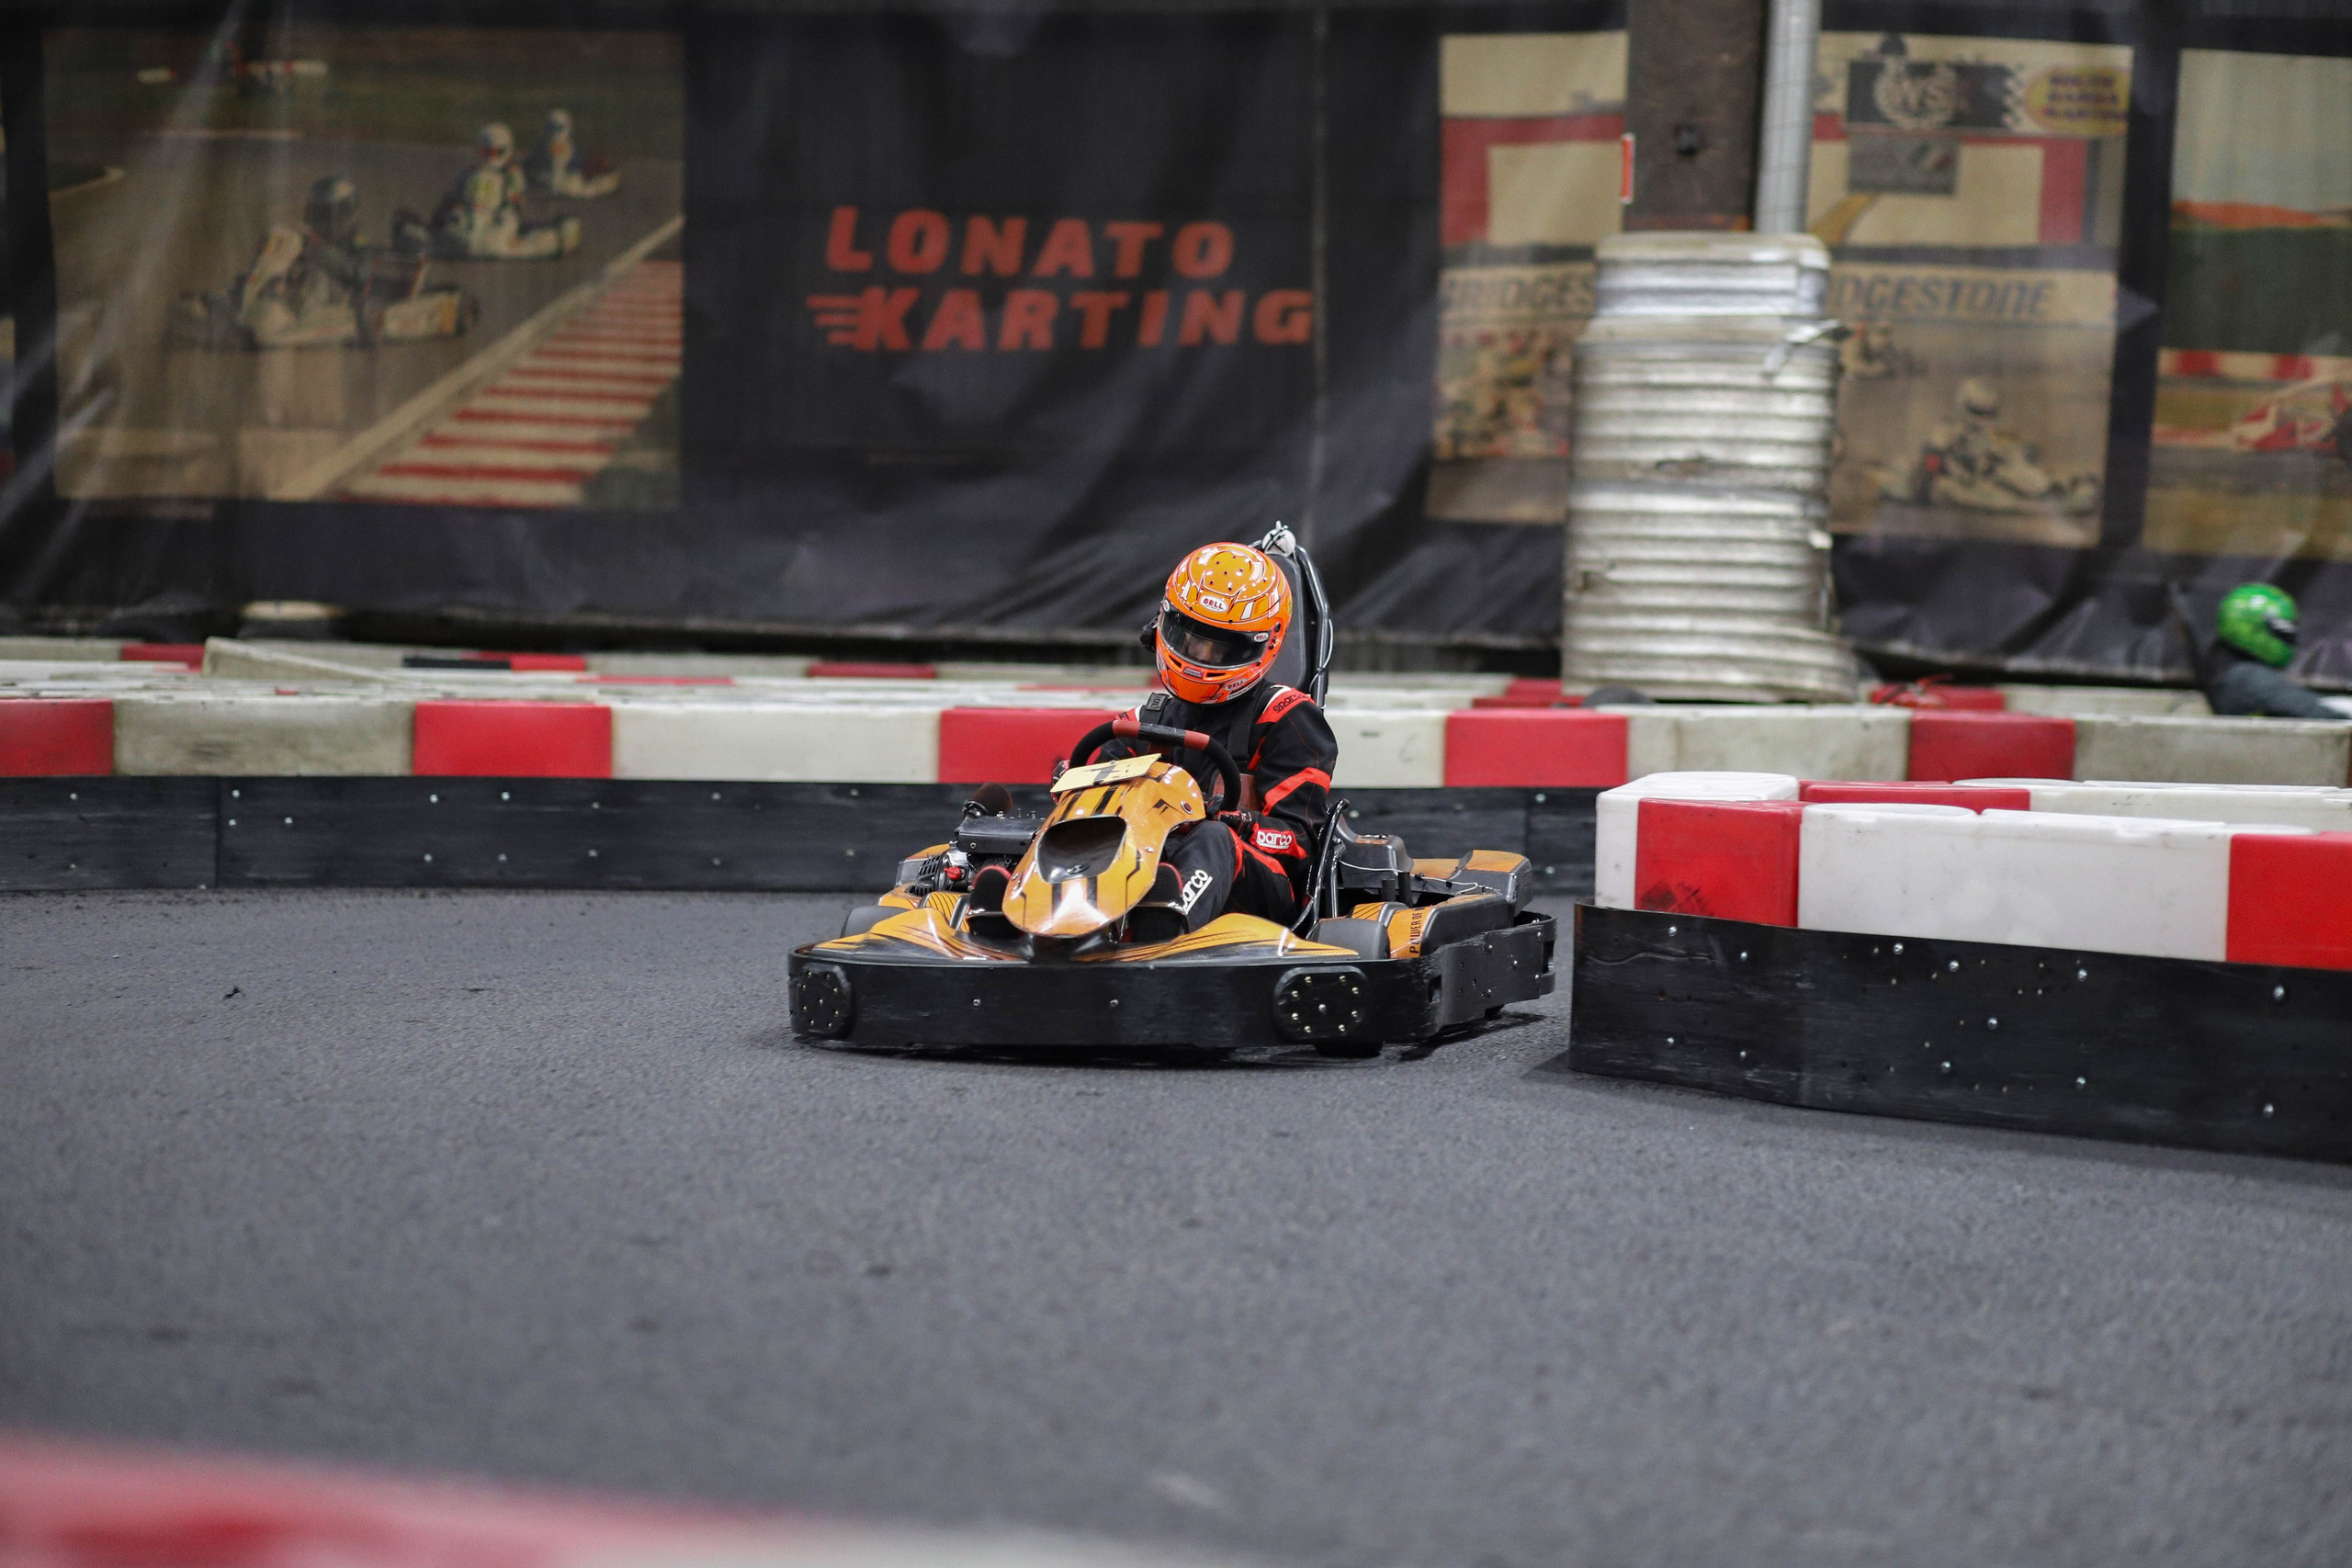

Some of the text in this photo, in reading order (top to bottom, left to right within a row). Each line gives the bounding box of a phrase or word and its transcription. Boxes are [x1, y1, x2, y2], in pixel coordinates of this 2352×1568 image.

[827, 205, 1234, 278] LONATO
[847, 286, 1313, 351] KARTING
[1203, 597, 1224, 610] BELL
[1227, 680, 1244, 689] BELL
[1256, 830, 1293, 848] parco
[1182, 869, 1210, 912] arco
[1409, 920, 1422, 953] POWER
